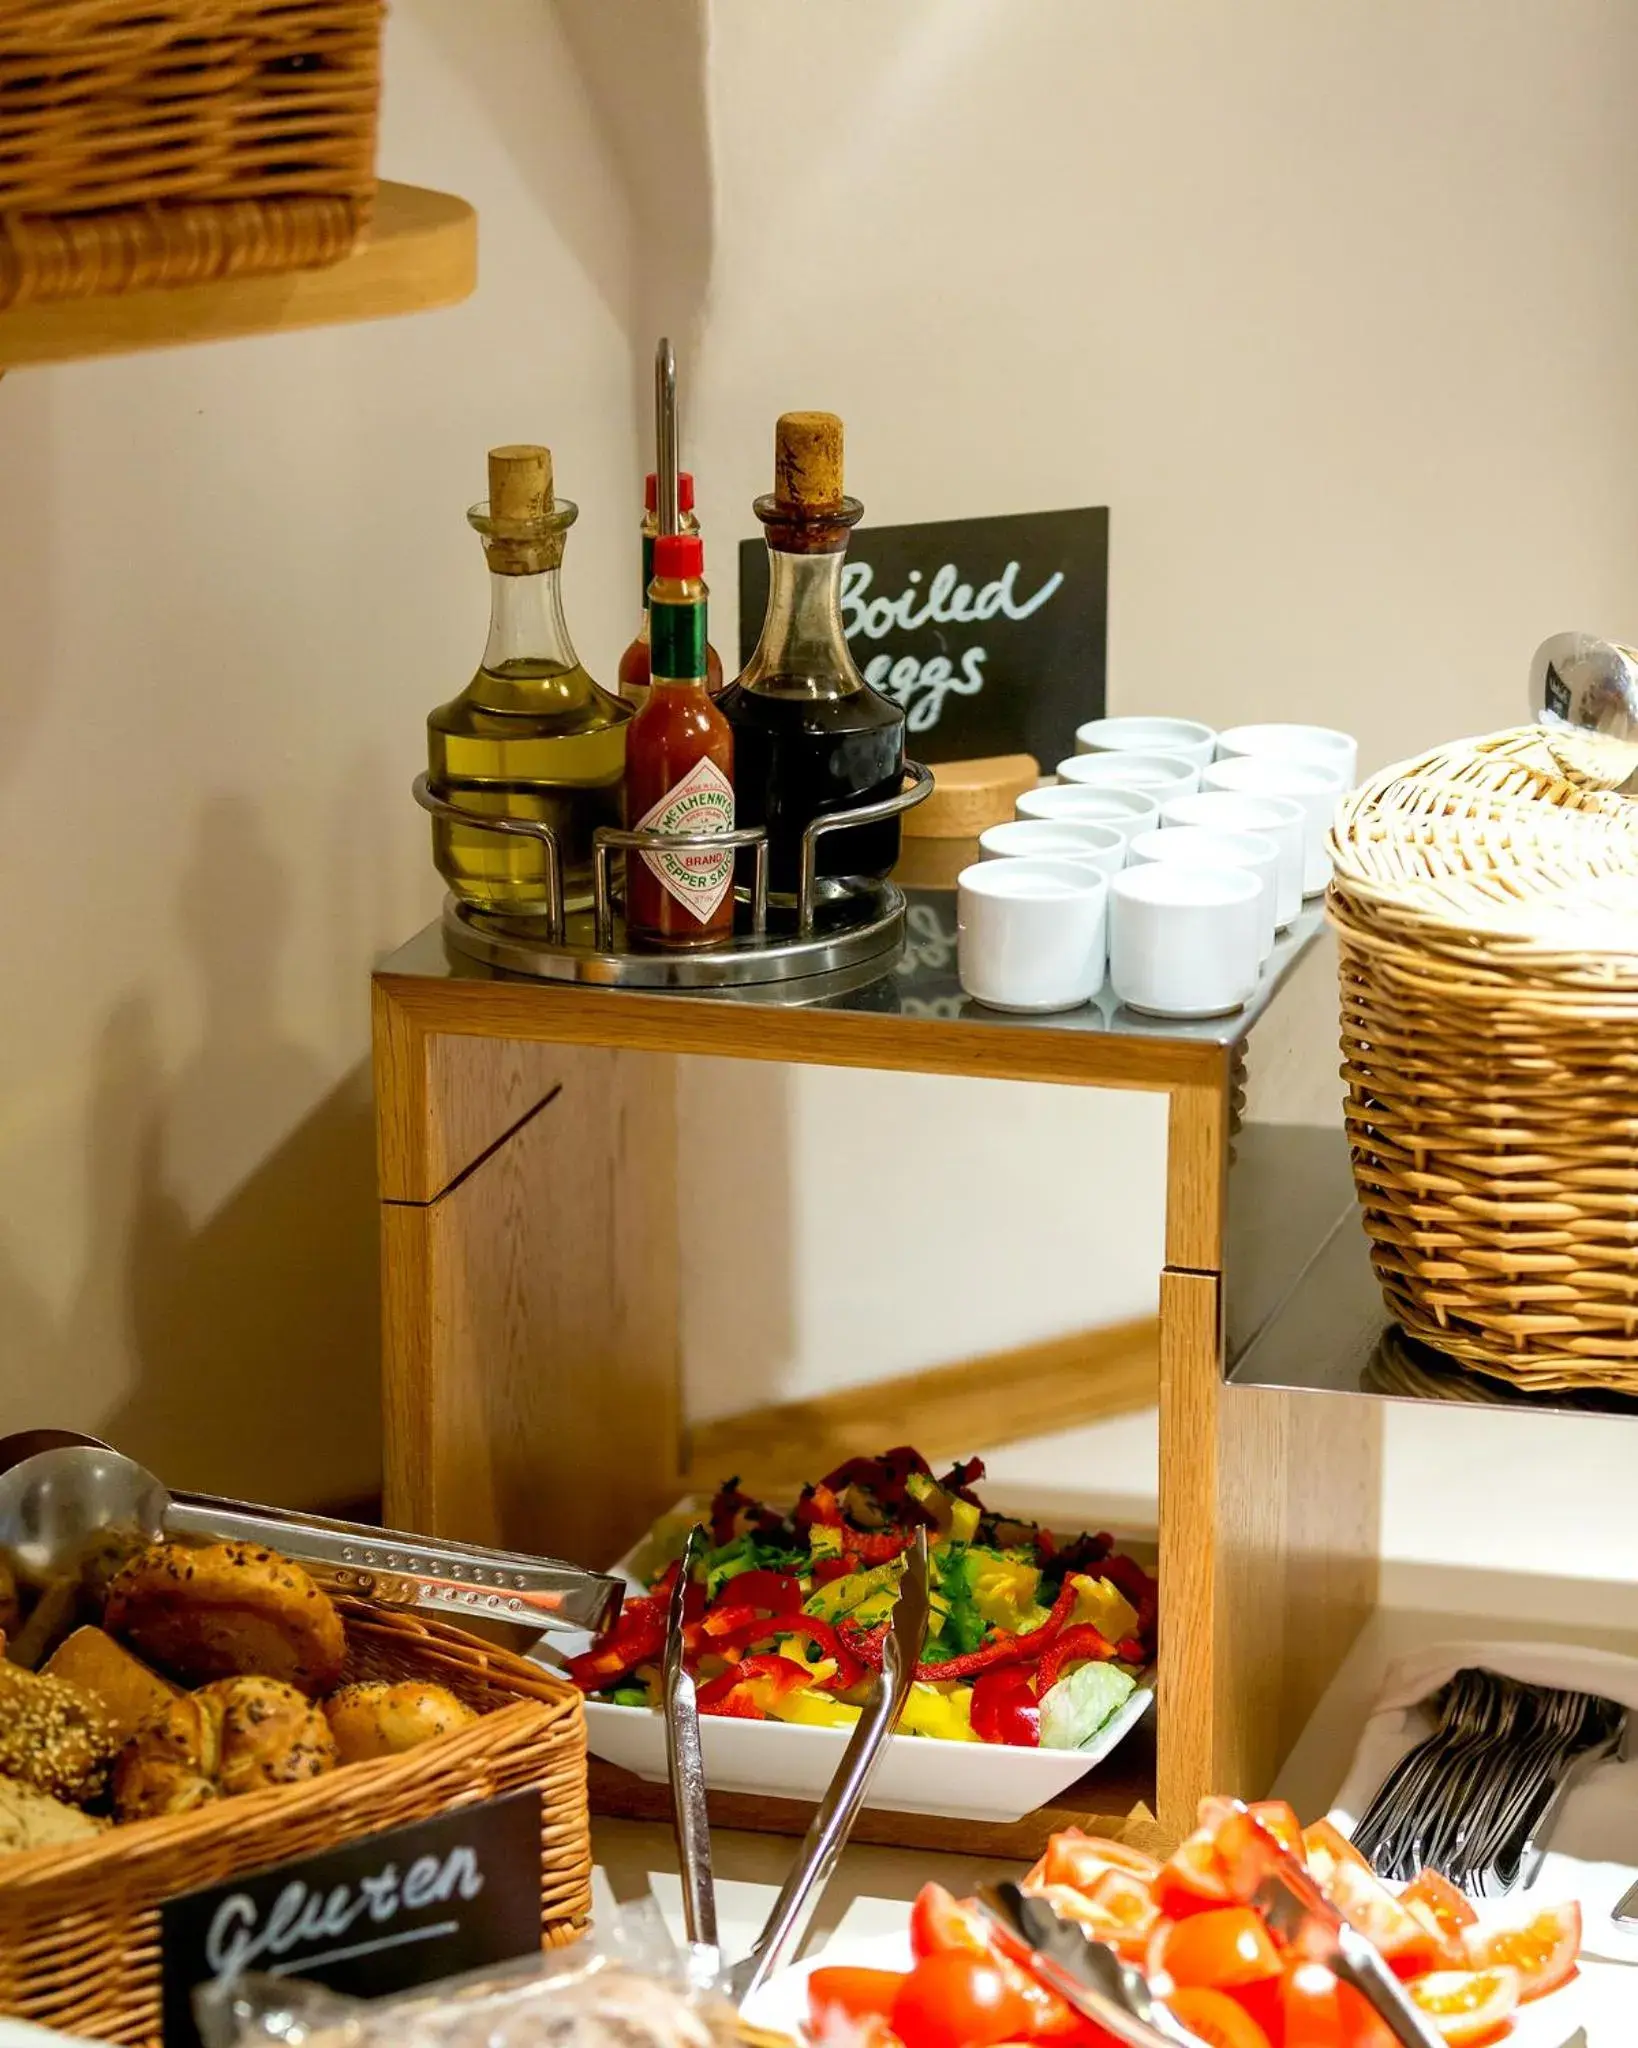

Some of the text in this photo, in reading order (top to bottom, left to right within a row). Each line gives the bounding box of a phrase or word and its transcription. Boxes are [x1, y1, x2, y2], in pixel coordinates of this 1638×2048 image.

[839, 561, 1065, 639] Boiled
[864, 646, 988, 733] eggs
[661, 853, 707, 887] PEPPER
[685, 852, 723, 867] BRAND
